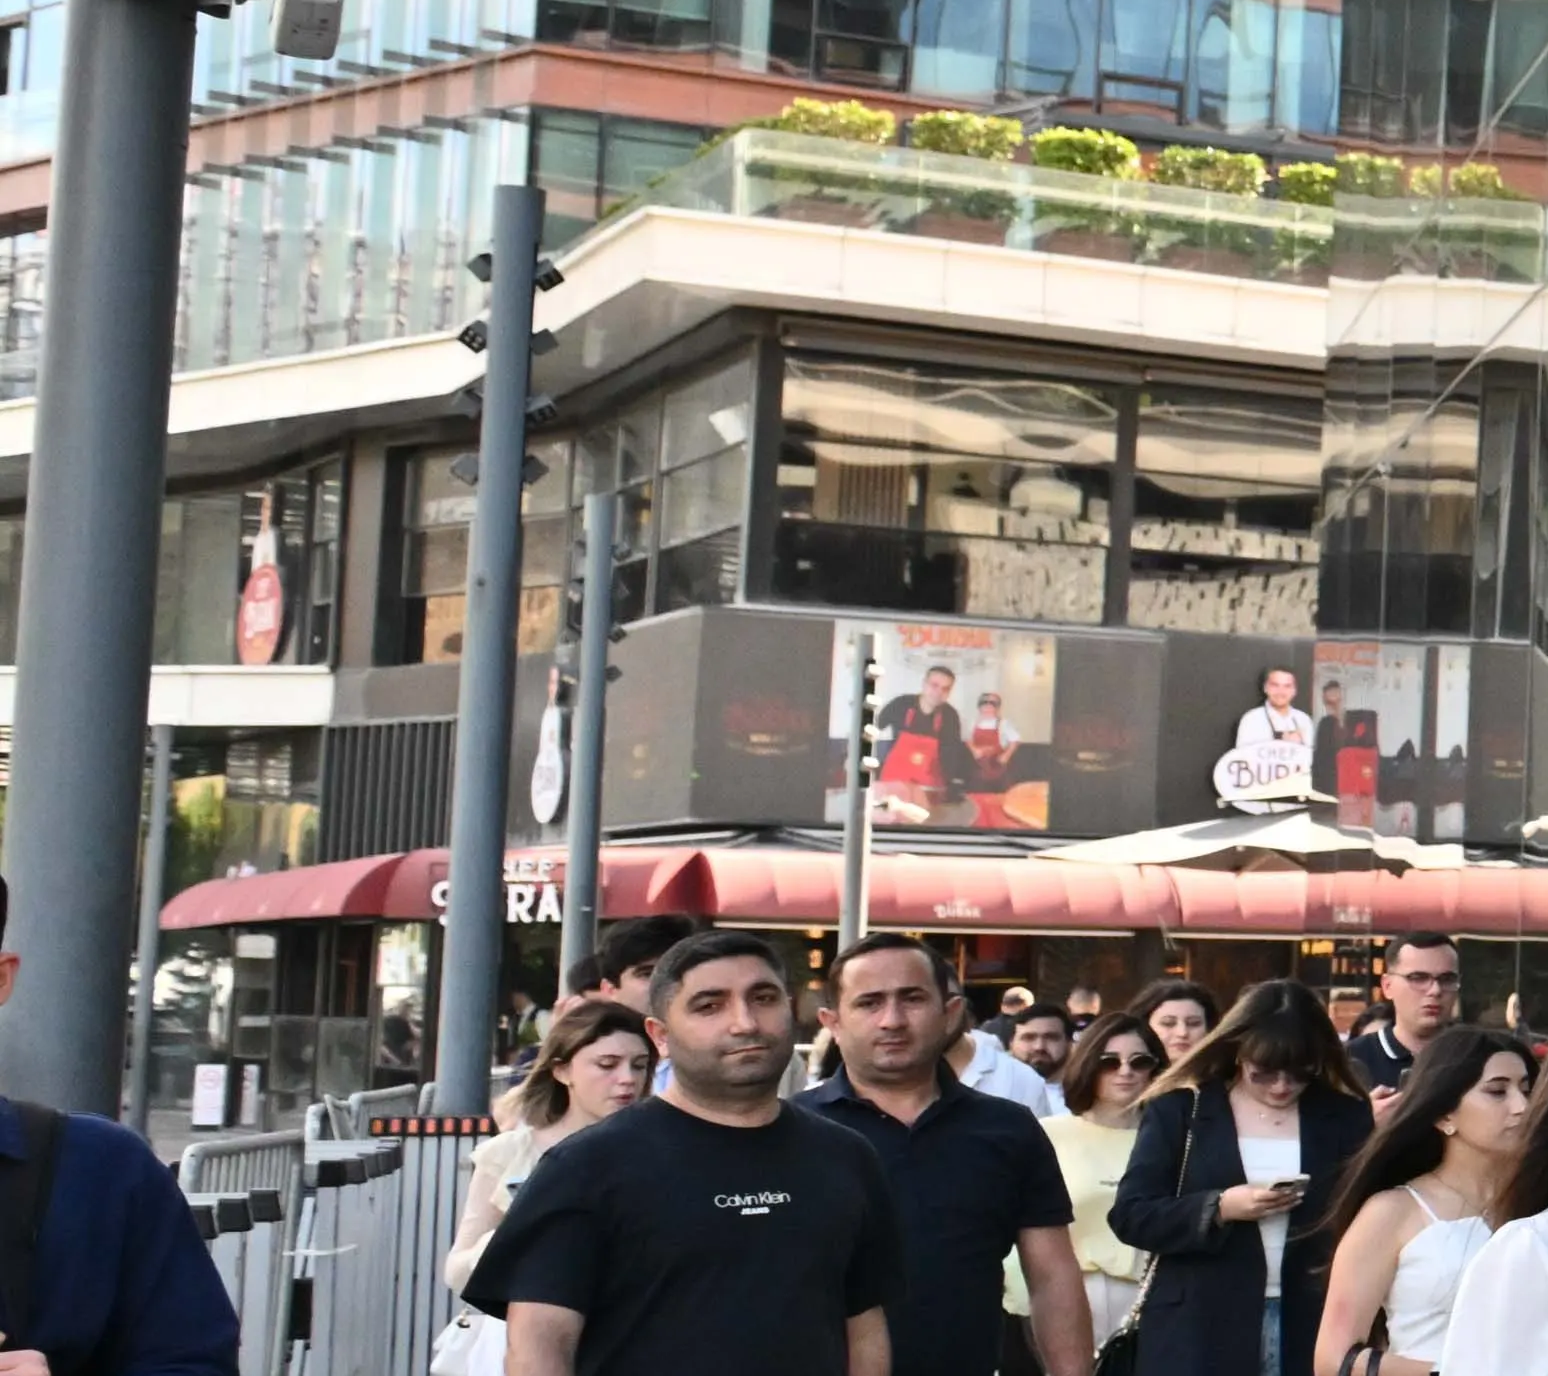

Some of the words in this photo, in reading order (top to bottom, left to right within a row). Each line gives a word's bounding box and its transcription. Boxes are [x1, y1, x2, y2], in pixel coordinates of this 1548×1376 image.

[1257, 746, 1298, 761] CHEF
[503, 858, 554, 882] HEF
[758, 1190, 791, 1205] Klein
